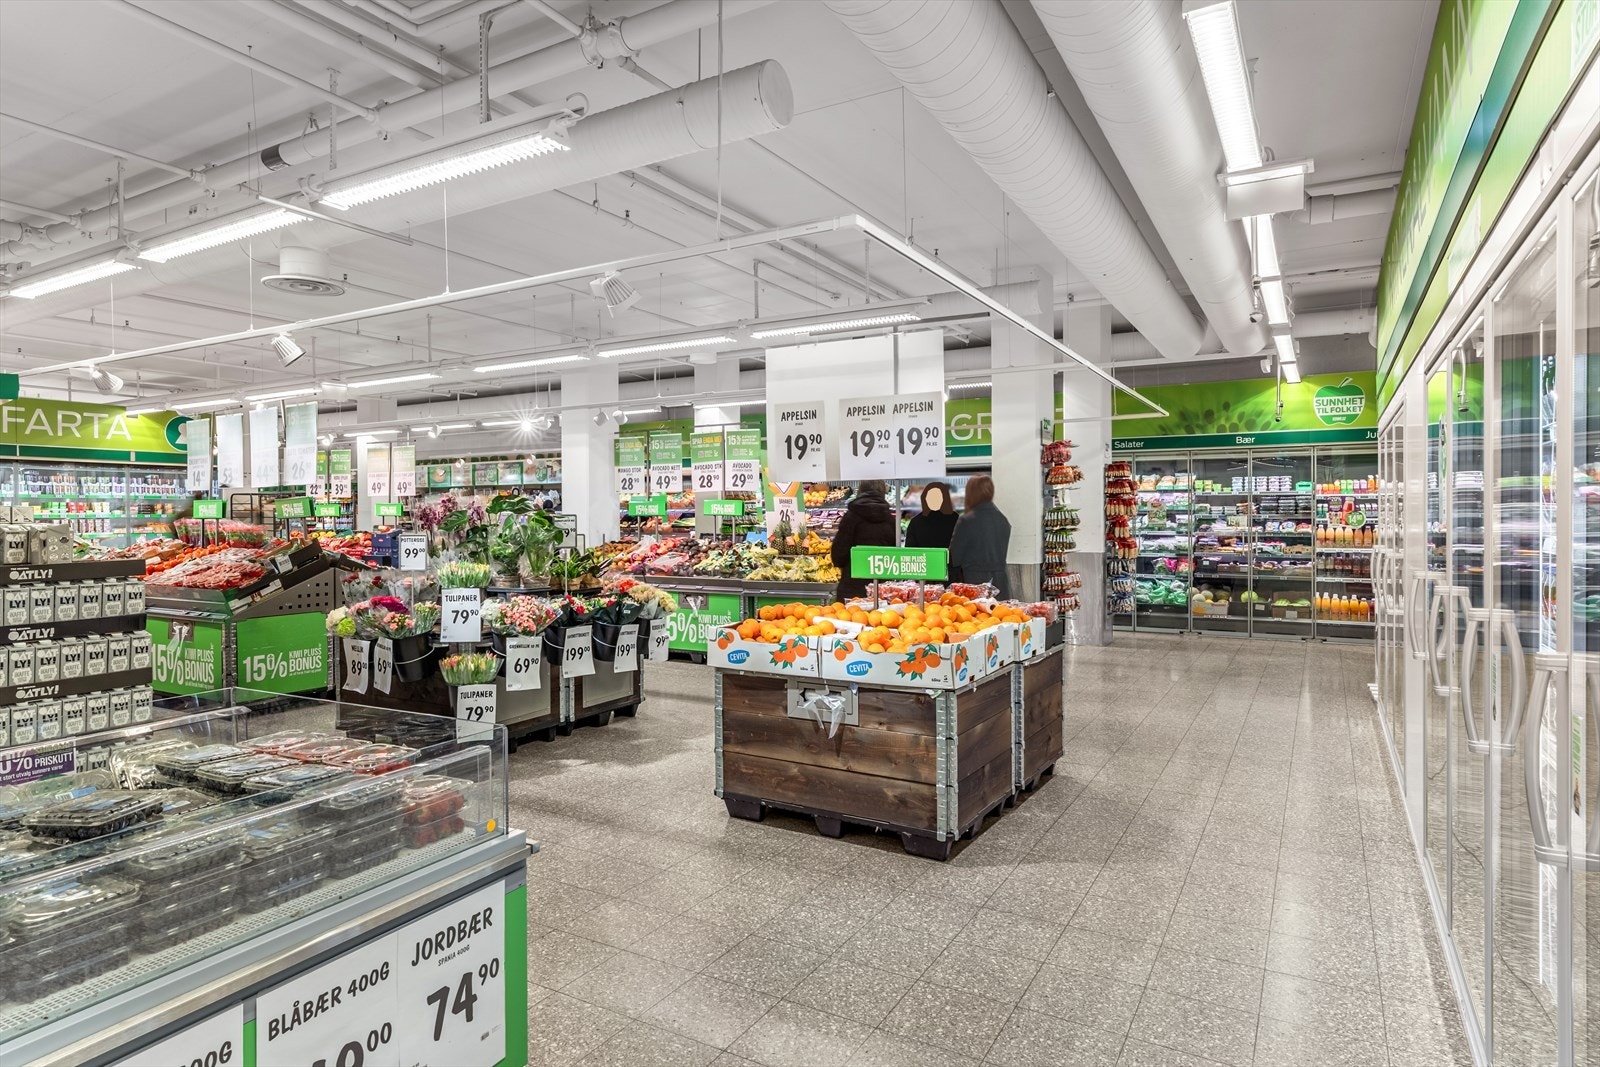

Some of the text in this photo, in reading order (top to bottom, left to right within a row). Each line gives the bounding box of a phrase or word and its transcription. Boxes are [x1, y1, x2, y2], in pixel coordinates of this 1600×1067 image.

[893, 401, 934, 414] APPELSIN
[1315, 397, 1364, 407] SUNNHET
[780, 409, 817, 422] APPELSIN
[846, 405, 886, 418] APPELSIN
[1330, 405, 1363, 414] FOLKET
[2, 405, 132, 441] FARTA
[1114, 440, 1145, 449] Salater
[1235, 435, 1255, 444] Bær
[867, 555, 900, 576] 15%
[900, 562, 927, 573] BONUS
[445, 594, 478, 602] TULIPANER
[289, 655, 322, 673] BONUS
[729, 652, 747, 663] CEVITA
[184, 660, 215, 684] BONUS
[243, 652, 288, 683] 15%
[849, 663, 869, 673] CEVITA
[460, 690, 493, 699] TULIPANER
[35, 751, 73, 768] PRISKUTT
[411, 907, 493, 967] JORDBÆR
[438, 951, 456, 967] SPANIA
[268, 961, 390, 1041] BLÅBÆR 400G
